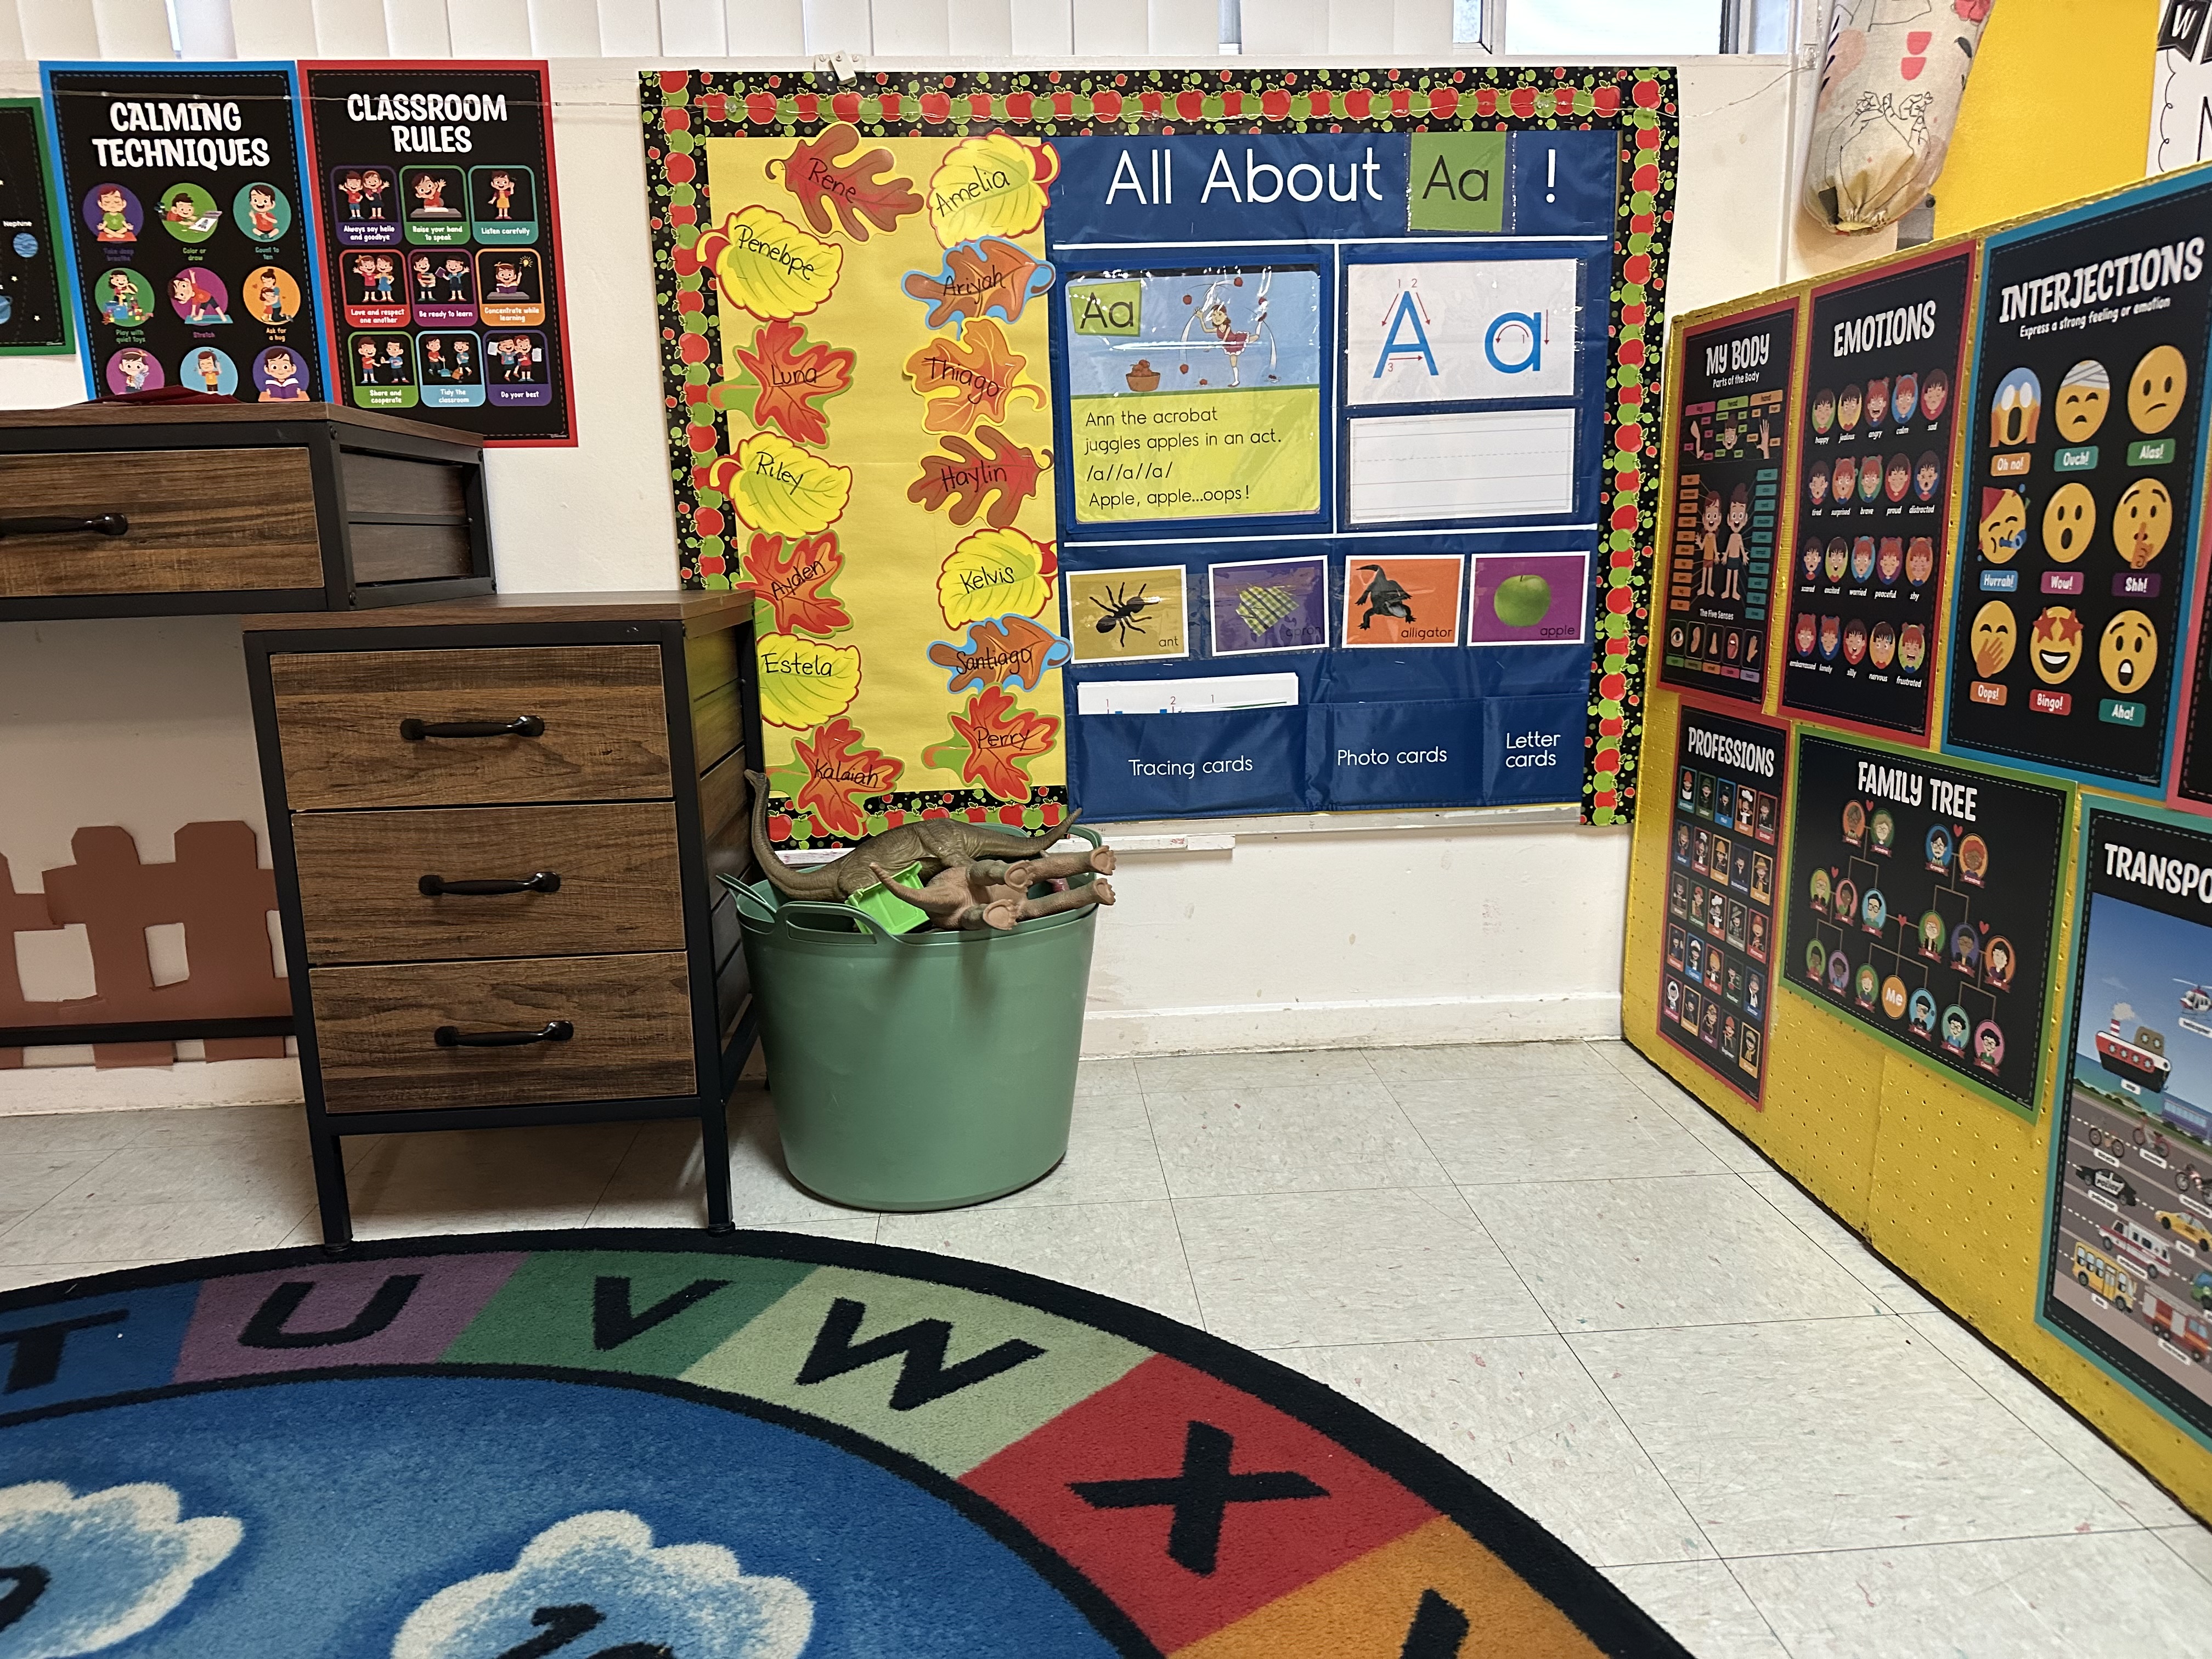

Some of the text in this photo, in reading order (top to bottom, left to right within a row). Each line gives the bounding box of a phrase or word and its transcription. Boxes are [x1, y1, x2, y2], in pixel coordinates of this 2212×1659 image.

[110, 102, 241, 132] CALMING
[347, 93, 507, 122] CLASSROOM
[392, 126, 472, 153] RULES
[92, 138, 270, 171] TECHNIQUES
[808, 157, 856, 204] Rene
[1105, 146, 1556, 205] All About Aa !
[935, 165, 1010, 217] Amelia
[364, 234, 390, 242] goodbye
[433, 234, 452, 242] speak
[501, 228, 530, 236] carefully
[735, 224, 815, 280] Penelope
[943, 265, 1007, 304] Ariyah
[1411, 279, 1418, 288] 2
[1999, 236, 2205, 324] INTERJECTIONS
[381, 308, 404, 317] respect
[1080, 292, 1134, 329] Aa
[2019, 297, 2171, 340] Express a strong feeling or emotion
[1373, 291, 1542, 379] A a
[1833, 300, 1936, 357] EMOTIONS
[1706, 333, 1770, 376] MY BODY
[772, 364, 817, 385] Luna
[1387, 362, 1393, 372] 3
[924, 357, 1000, 404] Thiago
[1713, 371, 1759, 388] Parts of the Body
[1086, 406, 1218, 427] Ann the acrobat
[1084, 428, 1282, 455] juggles apples in an act.
[2063, 452, 2090, 466] Ouch!
[2138, 444, 2164, 460] Alas!
[1997, 456, 2023, 471] Oh no!
[756, 452, 803, 495] Riley
[941, 464, 1007, 492] Haylin
[1089, 492, 1141, 510] Apple,
[1909, 505, 1935, 514] distracted
[1886, 506, 1902, 516] proud
[770, 560, 826, 601] Ayden
[960, 565, 1014, 594] Kelvis
[1984, 574, 2014, 588] Hurrah!
[2051, 576, 2073, 590] Wow!
[2125, 578, 2147, 593] Shh!
[1849, 588, 1867, 596] worried
[1875, 590, 1897, 599] peaceful
[1910, 592, 1919, 602] shy
[1700, 608, 1734, 620] The Five Senses
[1285, 625, 1322, 640] apron
[1401, 627, 1453, 641] alligator
[1540, 625, 1575, 637] apple
[1159, 636, 1179, 647] ant
[761, 653, 833, 677] Estela
[956, 647, 1032, 675] Santiago
[1847, 668, 1857, 678] silly
[1869, 673, 1888, 682] nervous
[1896, 676, 1922, 688] frustrated
[1170, 696, 1176, 705] 2
[1978, 685, 1999, 701] Oops!
[2037, 693, 2063, 710] Bingo!
[2112, 704, 2134, 721] Aha!
[973, 726, 1030, 752] Perry
[1506, 731, 1561, 749] Letter
[1337, 746, 1448, 768] Photo cards
[1505, 749, 1557, 768] cards
[1688, 726, 1775, 777] PROFESSIONS
[814, 761, 879, 788] Kalaiah
[1128, 754, 1253, 781] Tracing cards
[1857, 761, 1978, 822] FAMILY TREE
[2104, 843, 2212, 904] TRANSPO
[1885, 988, 1903, 1007] Me
[237, 1273, 424, 1350] U
[591, 1275, 734, 1351] V
[794, 1295, 1048, 1412] W
[1064, 1420, 1331, 1576] X
